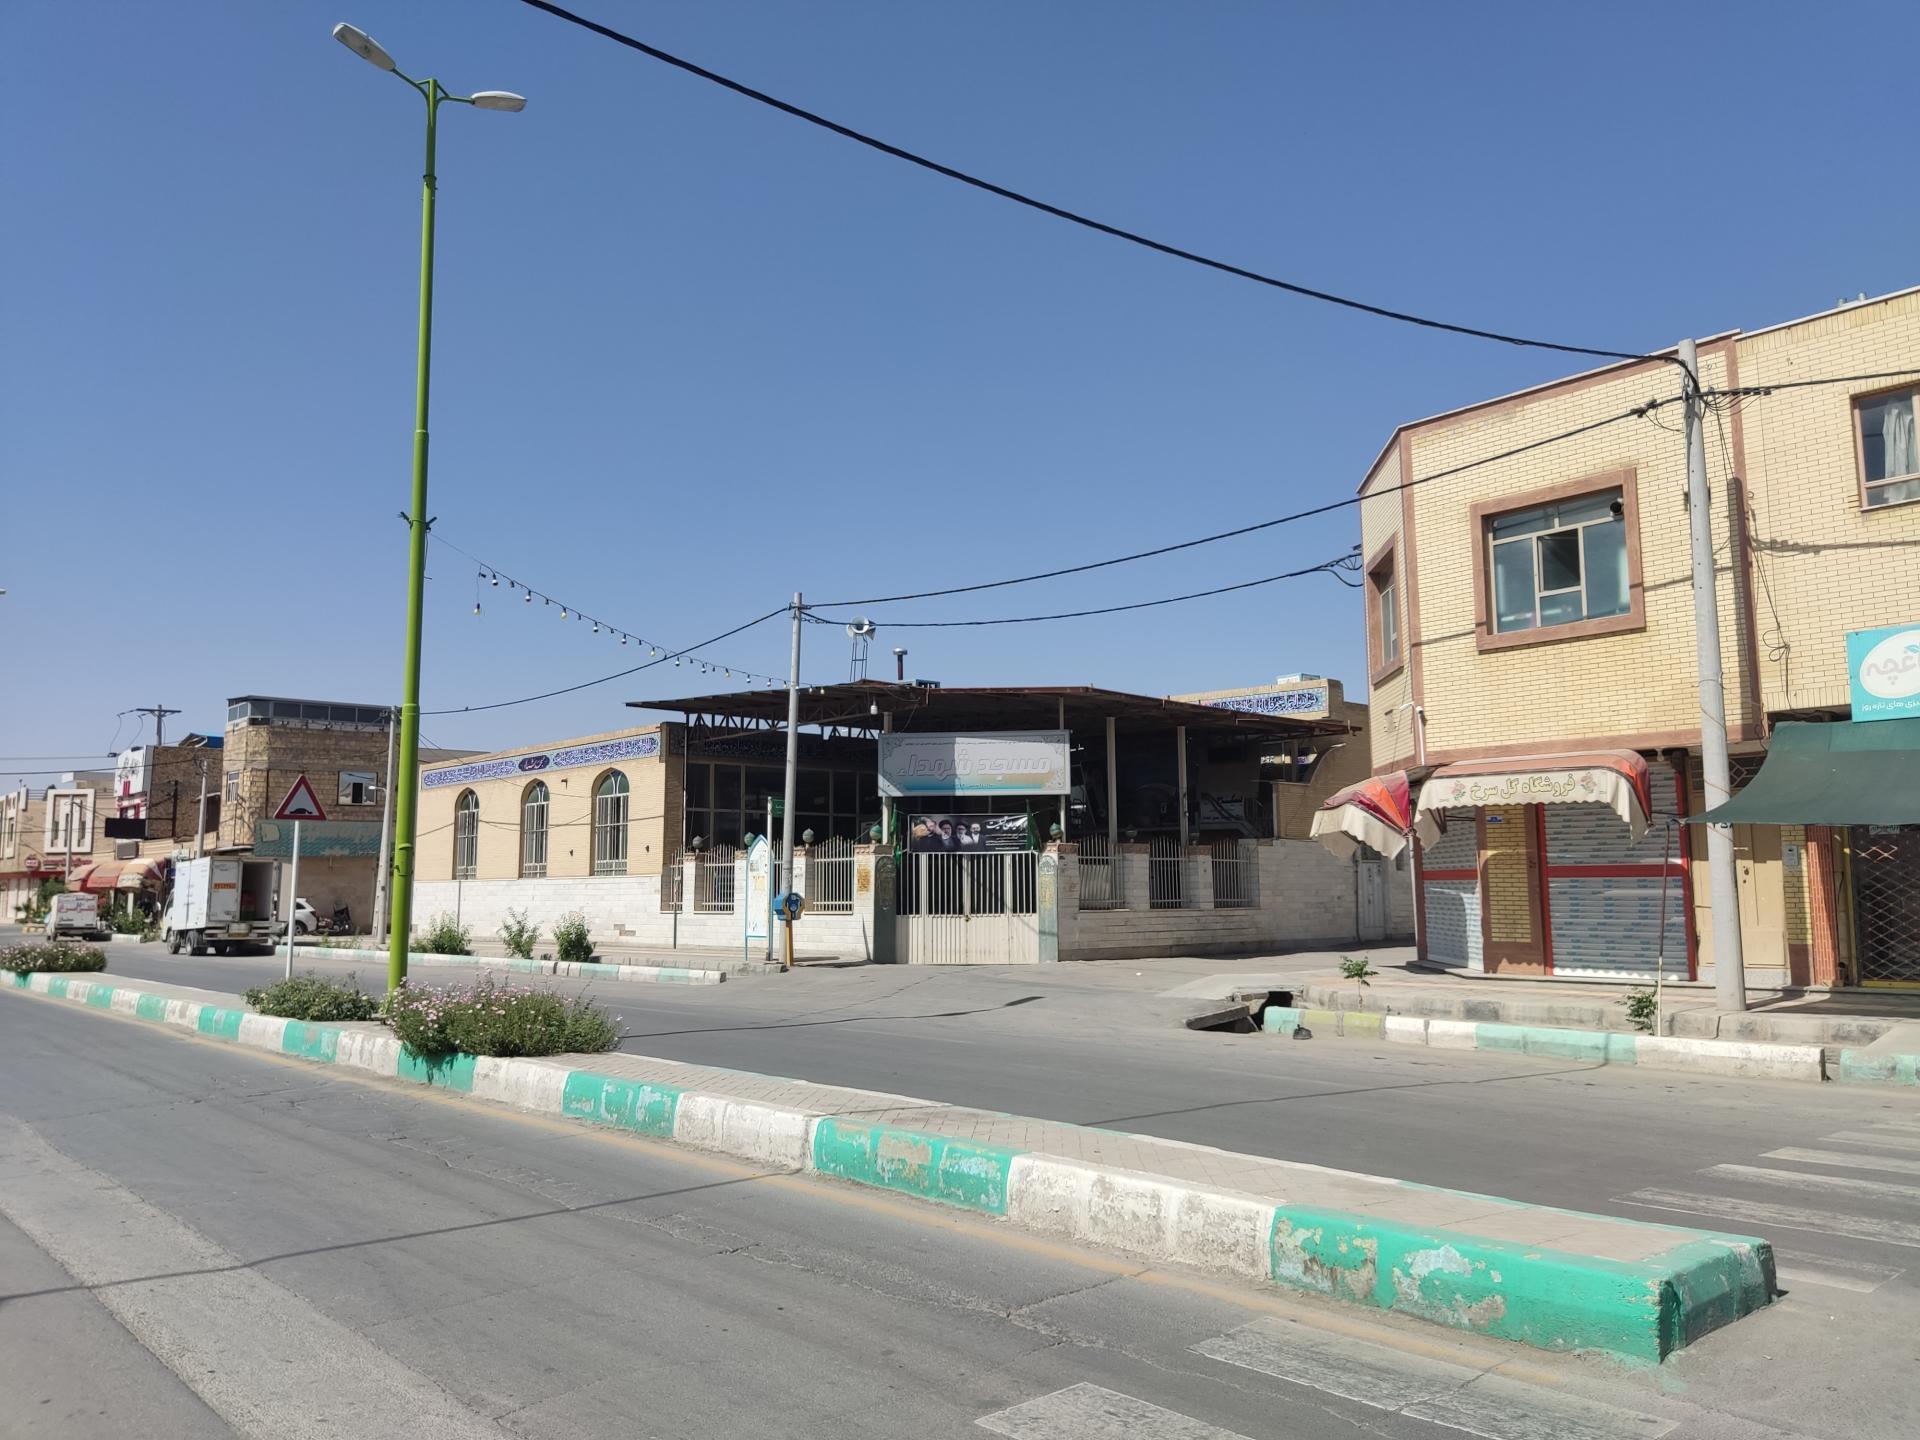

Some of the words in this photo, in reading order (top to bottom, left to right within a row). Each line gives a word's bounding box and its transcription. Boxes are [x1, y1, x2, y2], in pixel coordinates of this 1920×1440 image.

[977, 756, 1052, 782] مسجد
[1469, 781, 1499, 802] سرخ
[1500, 777, 1520, 800] گل
[1521, 772, 1576, 798] فروشگاه
